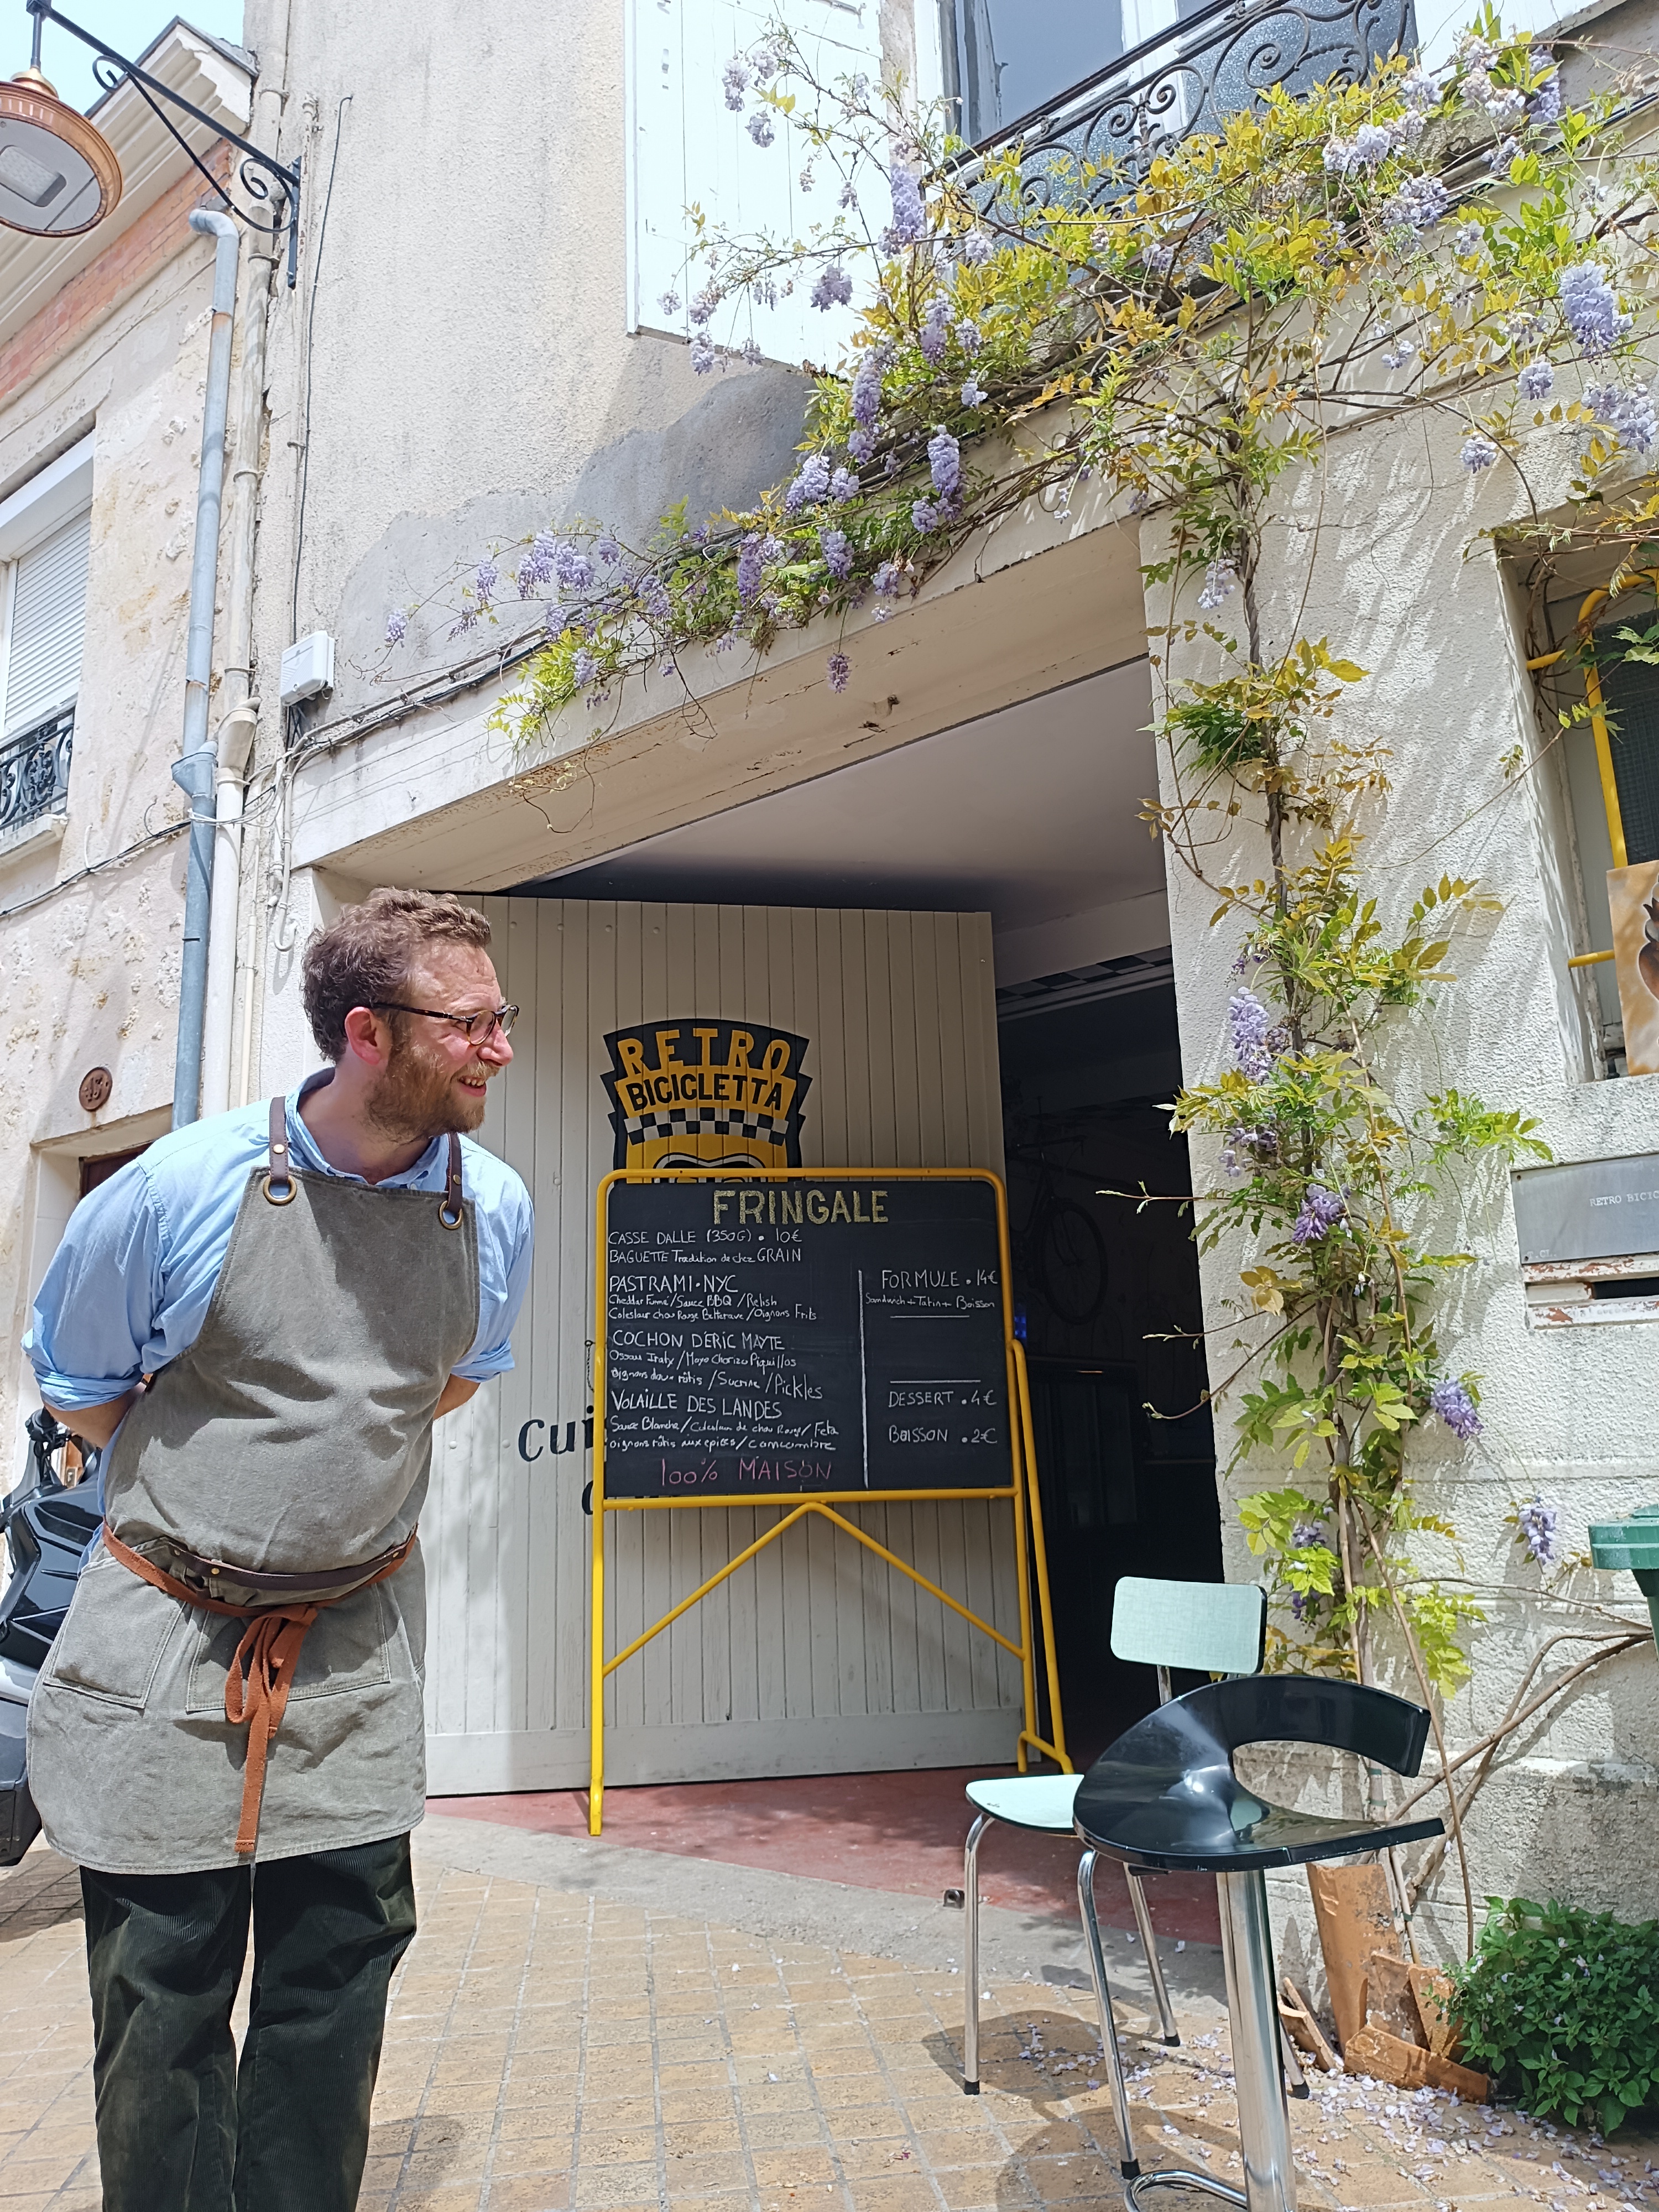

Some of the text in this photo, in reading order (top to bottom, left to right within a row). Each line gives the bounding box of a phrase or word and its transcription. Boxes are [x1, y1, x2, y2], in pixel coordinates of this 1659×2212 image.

[617, 1027, 791, 1078] RETRO
[626, 1073, 782, 1112] BICICLETTA
[713, 1190, 889, 1225] FRINGALE
[1589, 1195, 1621, 1207] RETRO
[608, 1231, 649, 1244] CASSE
[657, 1230, 696, 1244] DALLE
[707, 1229, 752, 1243] (350G)
[776, 1228, 802, 1243] 10€
[609, 1248, 801, 1263] BAGUETTE Tradition de chez GRAIN
[882, 1269, 960, 1289] FORMULE
[977, 1269, 998, 1286] 14€
[608, 1294, 644, 1306] Cheddar
[707, 1295, 732, 1307] BBQ
[956, 1295, 995, 1310] Boisson
[795, 1303, 817, 1320] Frits
[613, 1329, 683, 1347] COCHON
[711, 1353, 748, 1365] Chorizo
[750, 1352, 796, 1375] Piquillos
[687, 1395, 716, 1413] DES
[722, 1398, 782, 1421] LANDES
[888, 1391, 954, 1407] DESSERT
[735, 1421, 748, 1431] de
[889, 1425, 948, 1443] BOISSON
[661, 1457, 831, 1486] 100% MAISON
